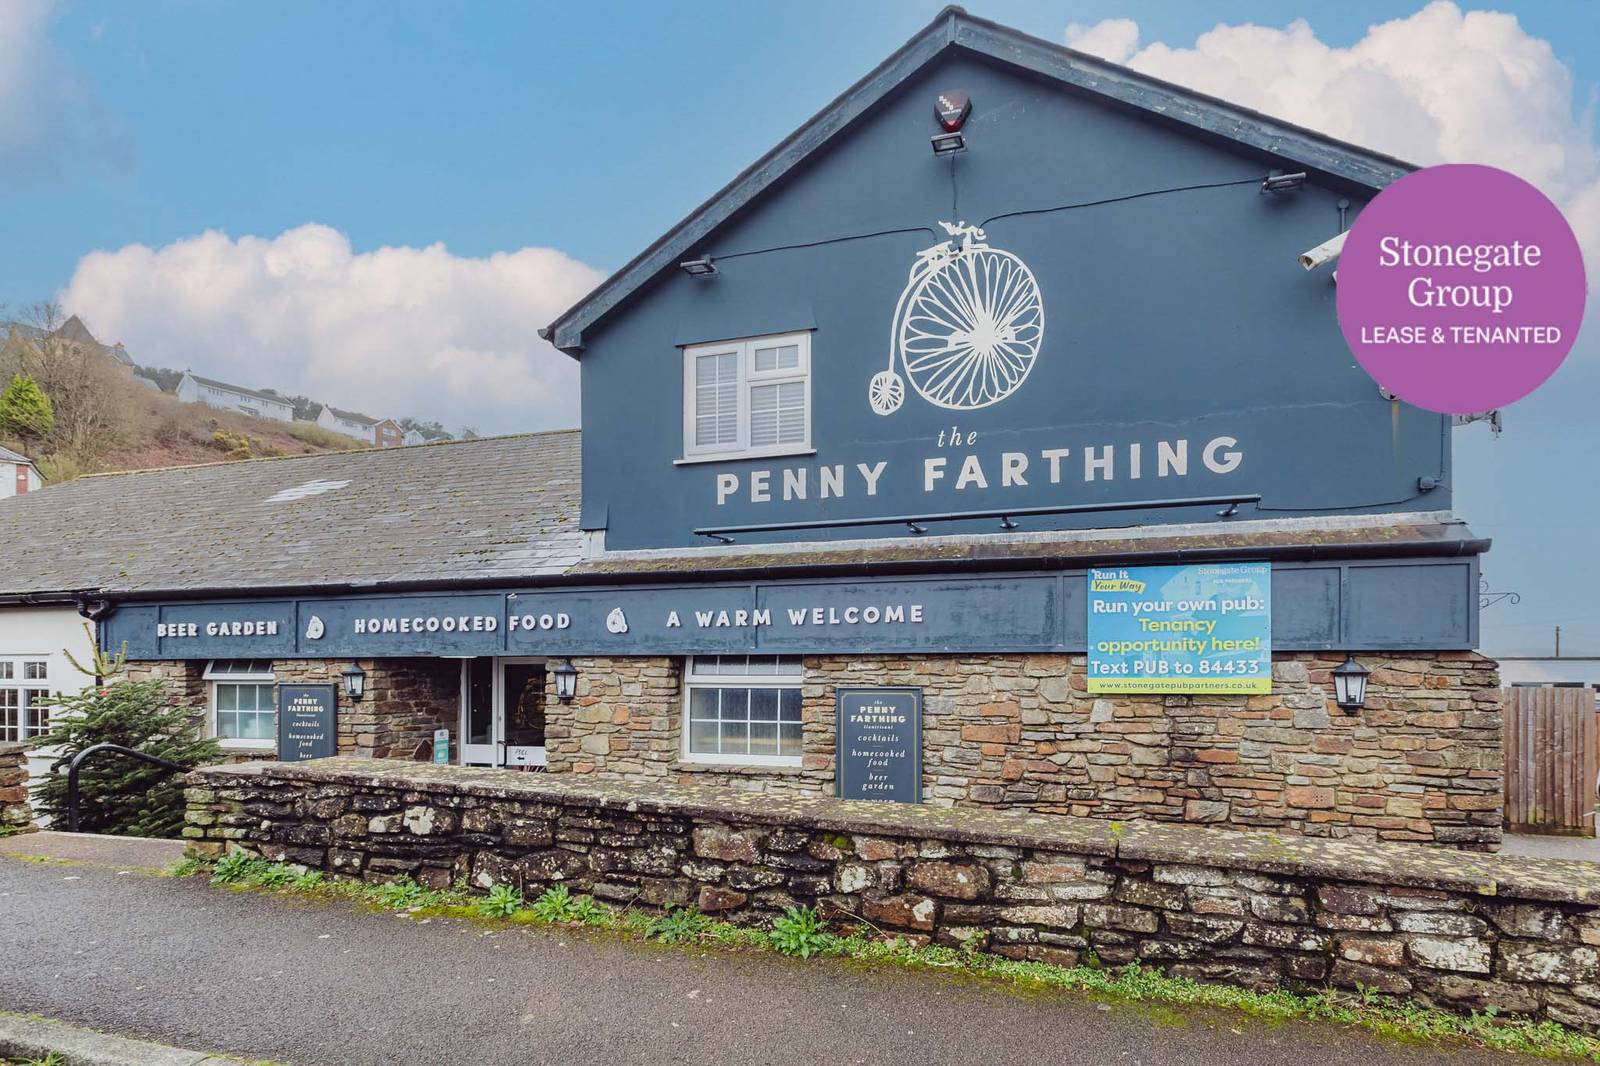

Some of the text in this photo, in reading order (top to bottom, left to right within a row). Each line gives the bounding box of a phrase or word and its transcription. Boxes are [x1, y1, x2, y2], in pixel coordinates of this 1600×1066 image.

[937, 428, 978, 448] the
[716, 436, 1243, 506] PENNY FARTHING
[1093, 569, 1128, 580] Run It
[1094, 581, 1142, 591] Your Way
[1093, 596, 1265, 616] Run your own pub:
[666, 605, 923, 627] A WARM WELCOME
[157, 621, 278, 637] BEER GARDEN
[354, 613, 570, 634] HOMECOOKED FOOD
[1139, 618, 1216, 634] Tenancy
[1097, 637, 1260, 656] opportunity here!
[1091, 660, 1259, 674] Text PUB to 84433
[1099, 679, 1257, 690] www.stonegatepubpartners.co.uk
[850, 715, 906, 723] FARTHING
[299, 740, 313, 748] food
[857, 734, 899, 742] cocktails
[852, 749, 905, 757] homecooked
[867, 759, 889, 767] food
[861, 783, 895, 791] garden
